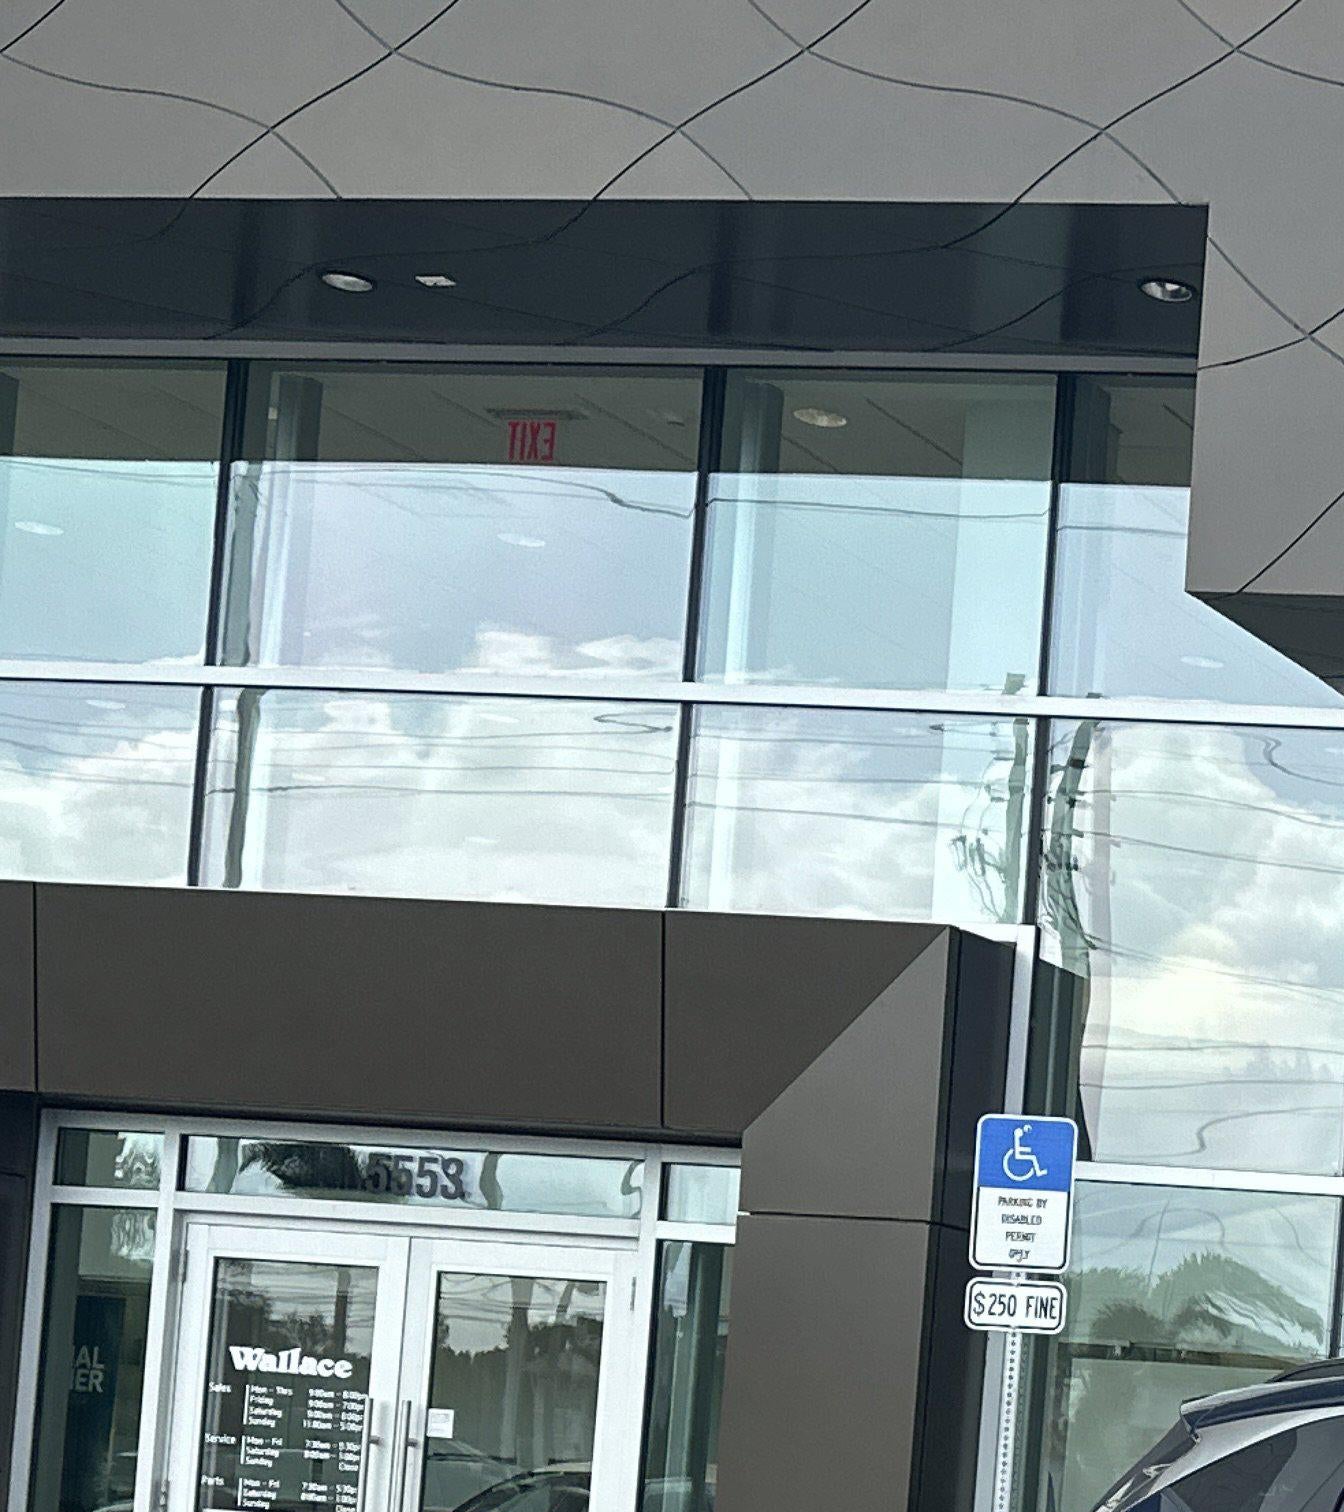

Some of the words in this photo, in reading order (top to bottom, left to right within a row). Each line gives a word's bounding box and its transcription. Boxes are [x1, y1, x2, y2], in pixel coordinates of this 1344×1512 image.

[366, 1152, 464, 1200] 5553
[997, 1195, 1033, 1209] PARKING
[1036, 1198, 1048, 1210] BY
[1001, 1213, 1042, 1226] DISABLED
[1005, 1231, 1036, 1243] PERMIT
[972, 1290, 1018, 1318] $250
[1024, 1295, 1059, 1320] FINE
[73, 1345, 105, 1369] AL
[228, 1345, 354, 1379] Wallace
[73, 1369, 105, 1393] ER
[209, 1381, 232, 1393] Sales
[248, 1416, 276, 1428] Sunday
[204, 1433, 237, 1445] Service
[245, 1456, 273, 1468] Sunday
[200, 1474, 225, 1486] Parts
[242, 1499, 270, 1510] Sunday
